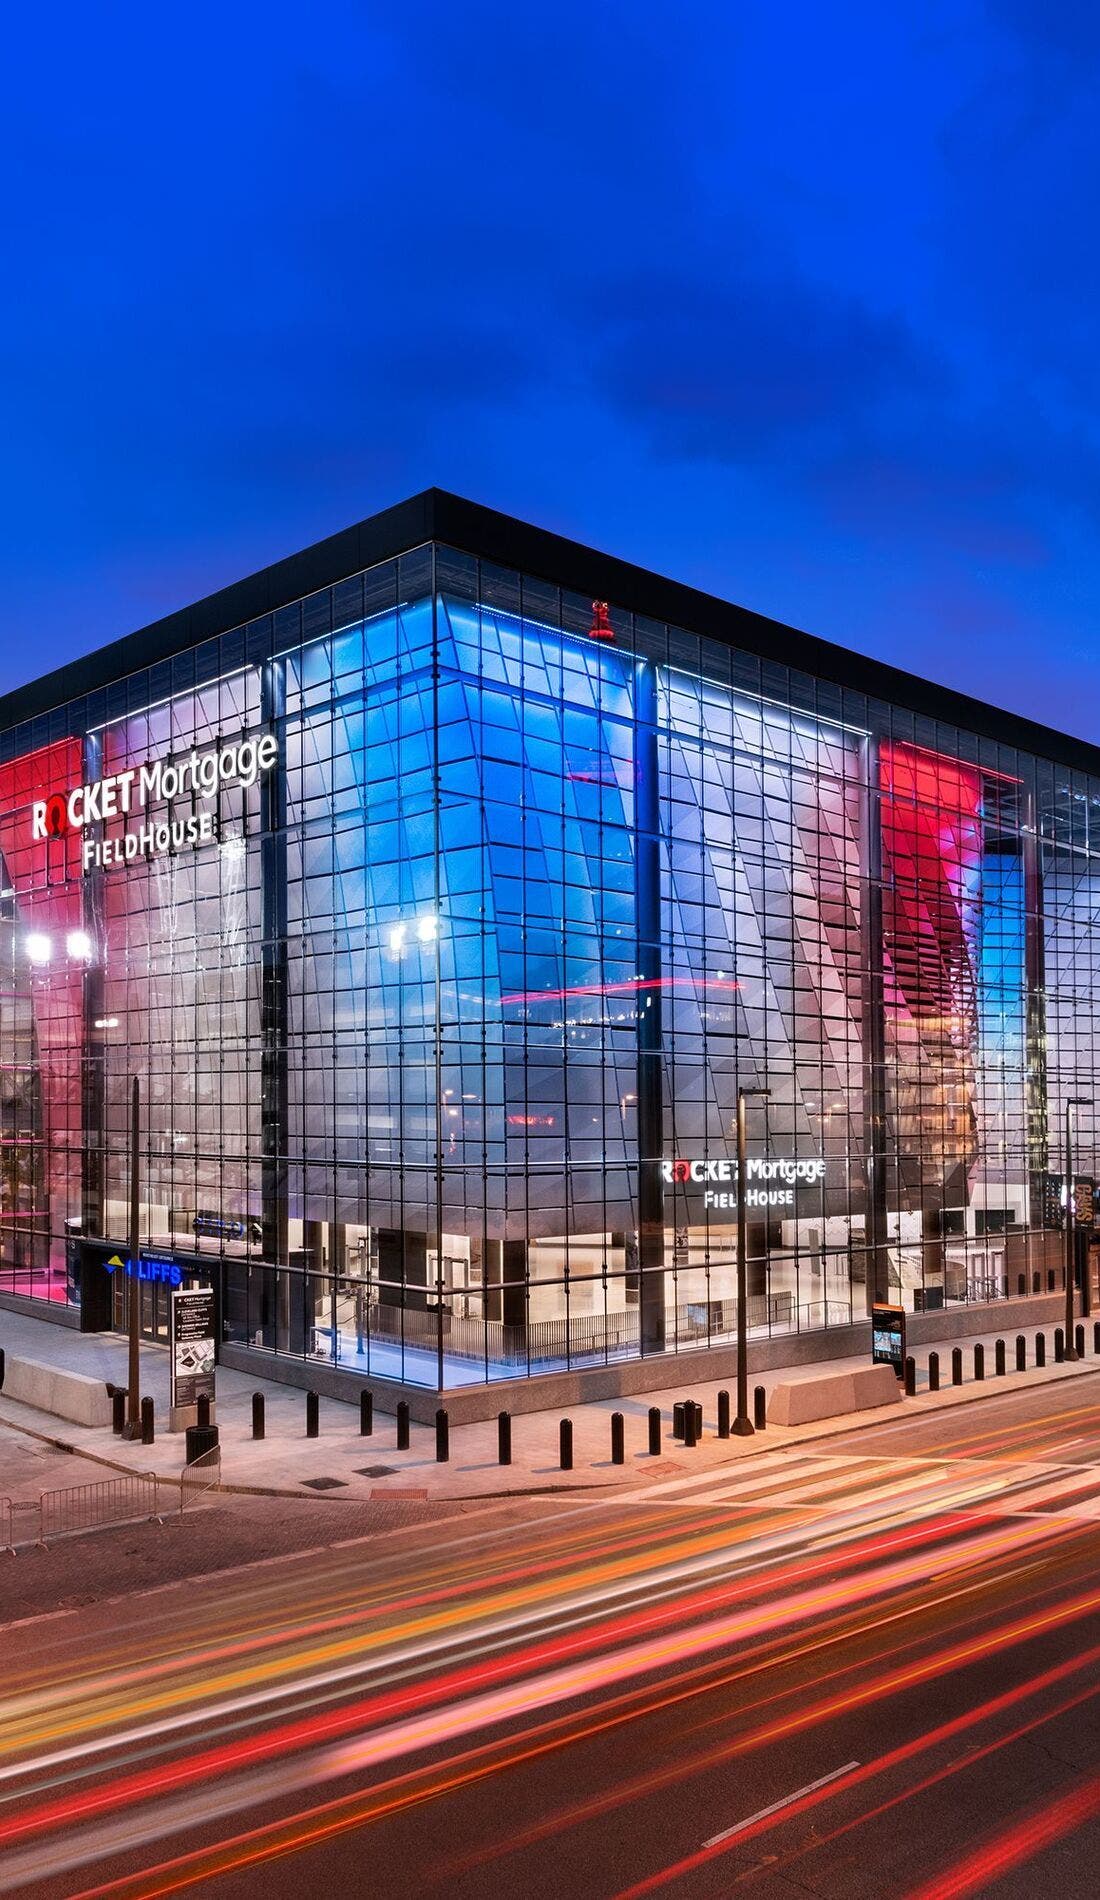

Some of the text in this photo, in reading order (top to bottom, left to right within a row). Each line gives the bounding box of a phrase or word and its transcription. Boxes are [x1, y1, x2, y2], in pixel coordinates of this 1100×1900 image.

[32, 735, 278, 840] ROCKET Mortgage
[83, 812, 214, 871] FIELDHOUSE
[746, 1158, 826, 1184] Mortgage
[704, 1189, 794, 1209] FIELHOUSE
